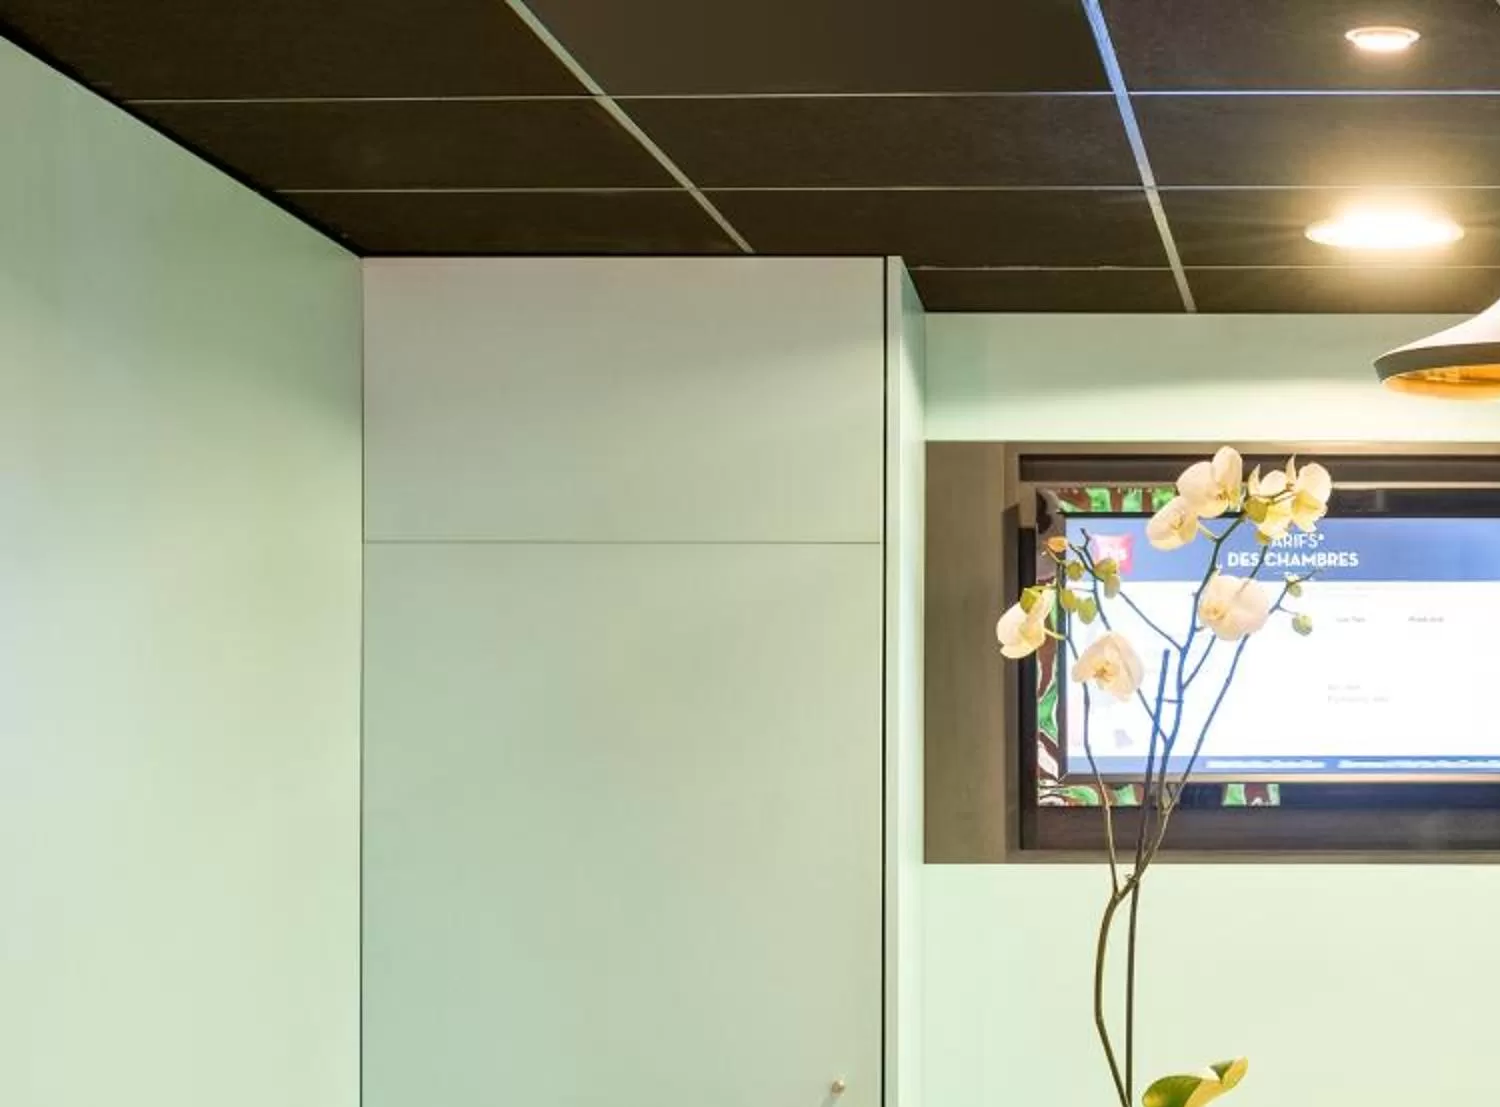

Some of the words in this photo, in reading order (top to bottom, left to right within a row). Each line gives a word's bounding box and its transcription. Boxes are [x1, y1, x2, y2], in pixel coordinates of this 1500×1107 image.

[1269, 533, 1325, 549] ARIFS
[1227, 551, 1260, 567] DES
[1264, 551, 1360, 567] CHAMBRES
